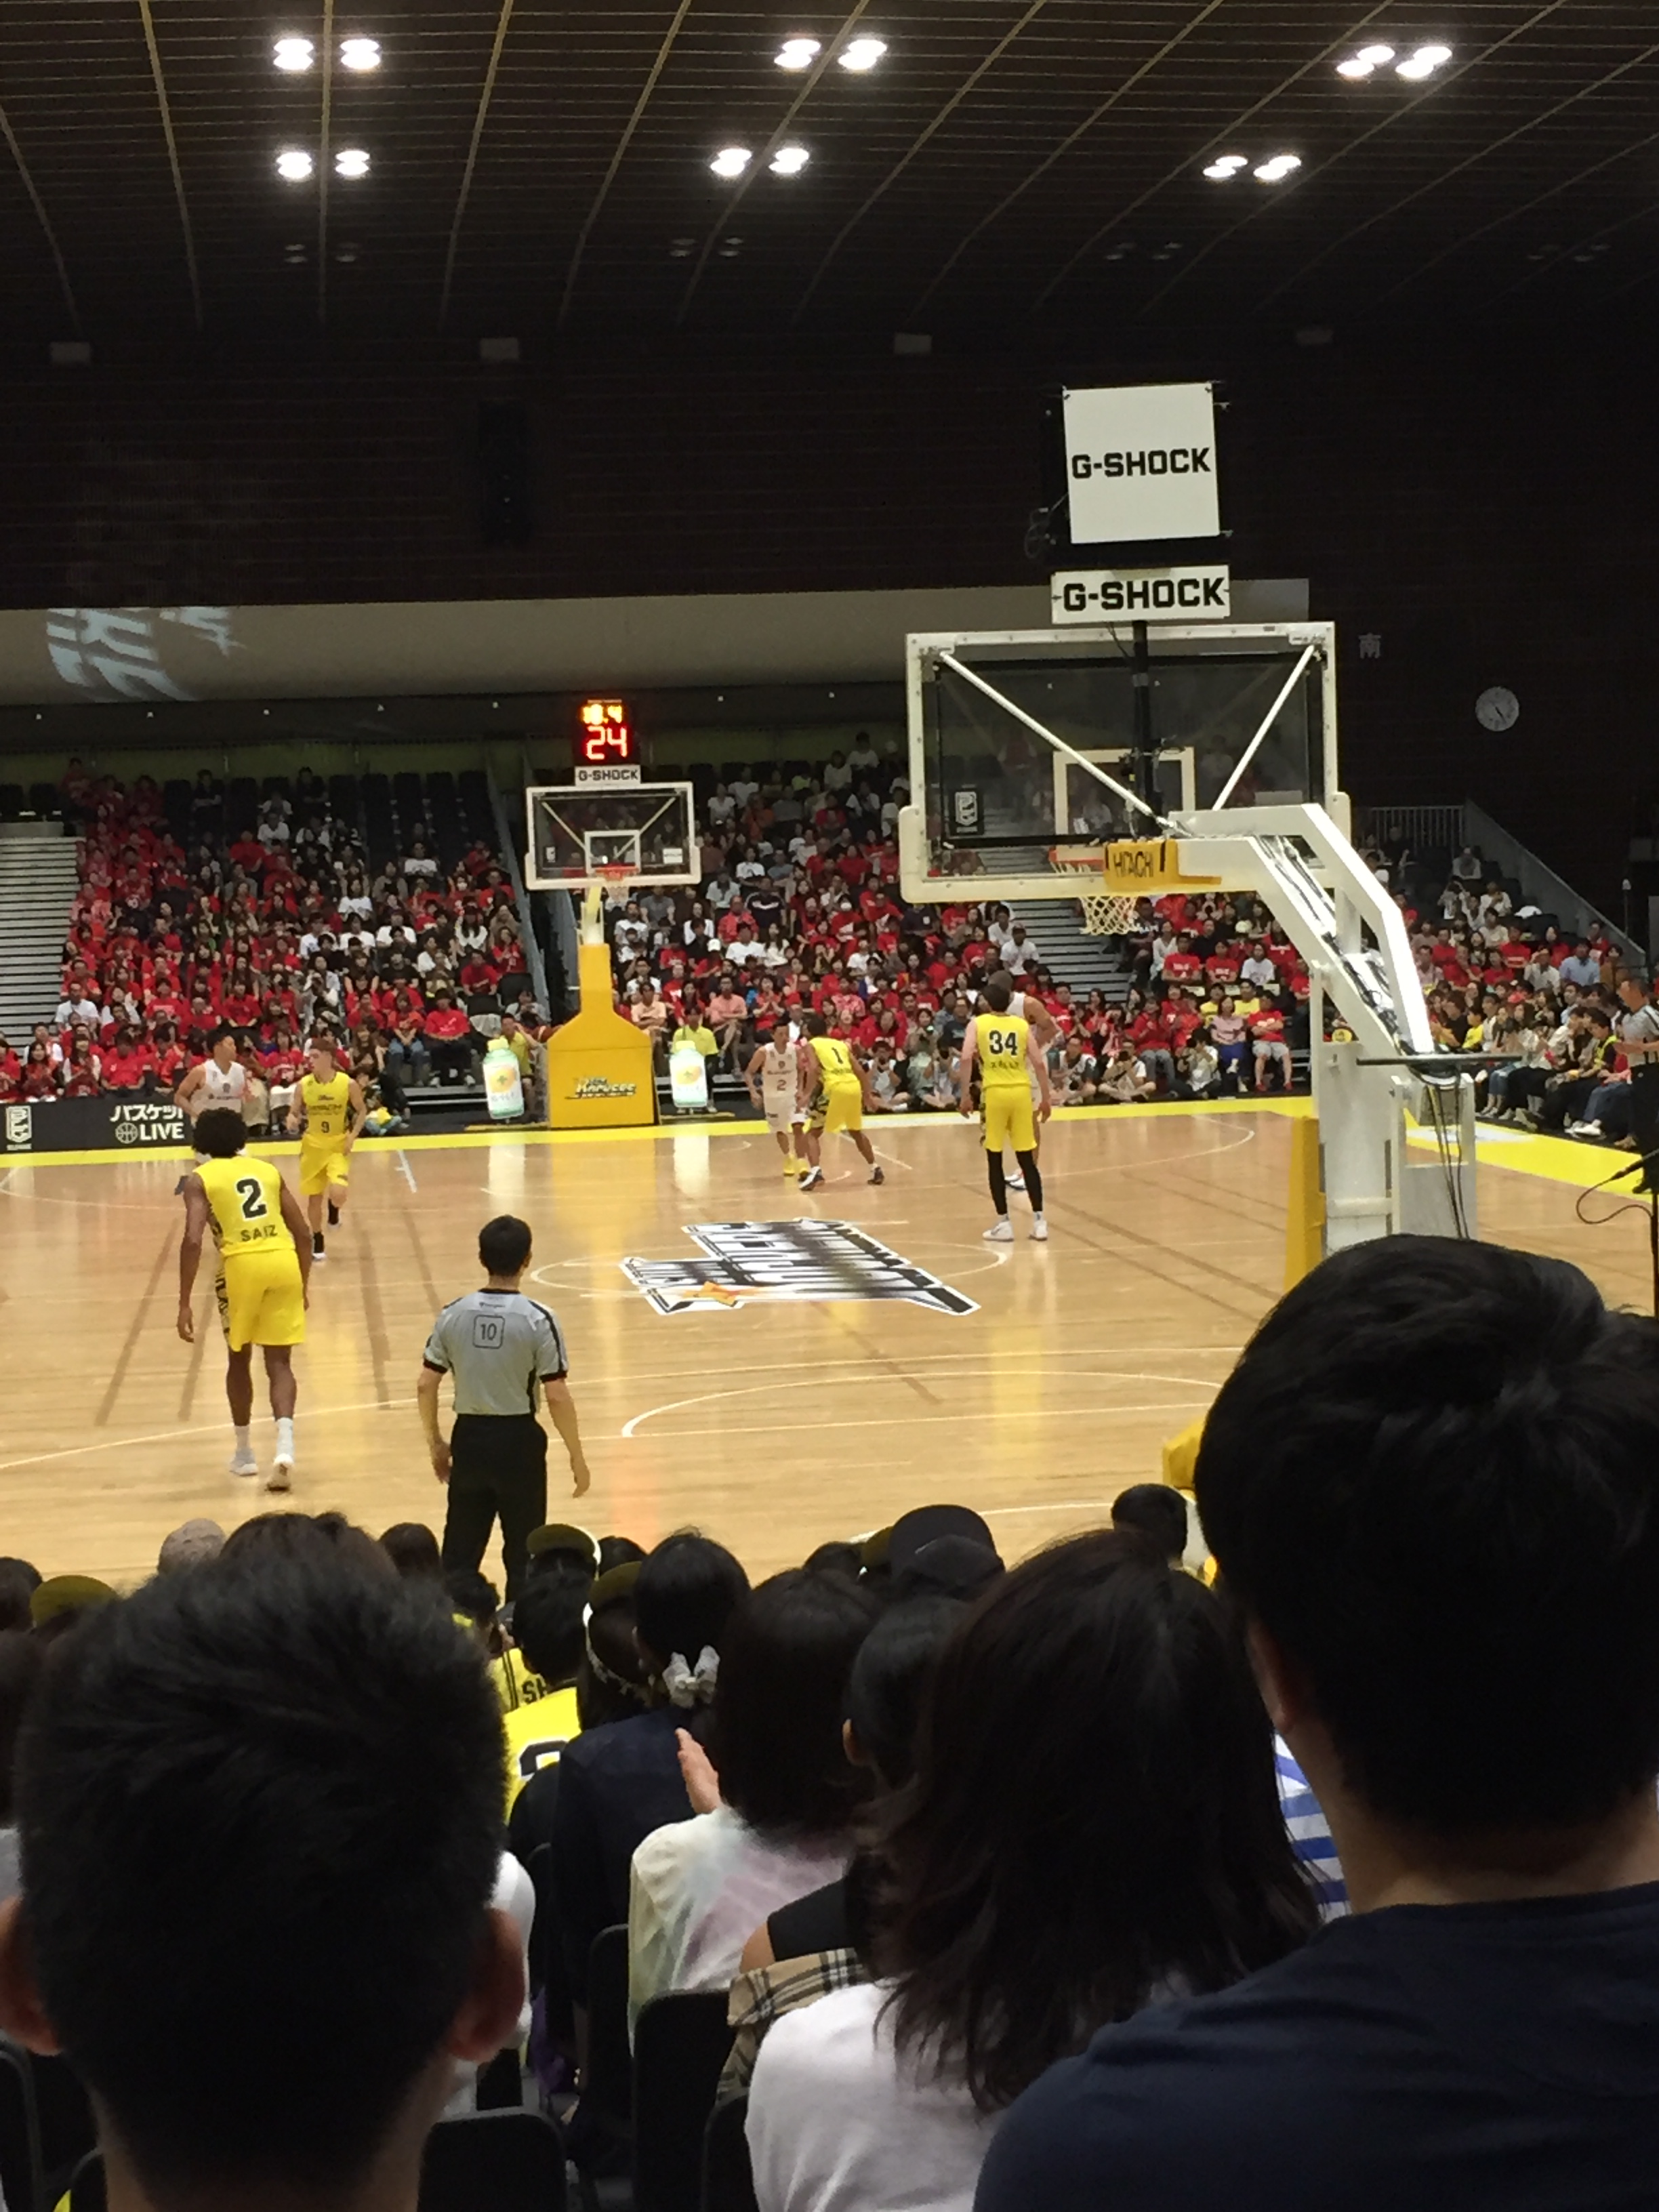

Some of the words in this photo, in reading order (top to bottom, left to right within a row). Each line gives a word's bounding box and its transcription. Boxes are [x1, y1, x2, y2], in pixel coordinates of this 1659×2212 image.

[1071, 447, 1211, 479] G-SHOCK
[1063, 577, 1225, 611] G-SHOCK
[586, 726, 628, 760] 24
[579, 769, 638, 781] G-SHOCK
[989, 1030, 1017, 1056] 34
[832, 1047, 843, 1065] 1
[777, 1080, 786, 1091] 2
[140, 1122, 184, 1141] LIVE
[321, 1122, 330, 1133] 9
[237, 1179, 267, 1218] 2
[241, 1225, 278, 1242] SAIZ
[480, 1323, 497, 1340] 10
